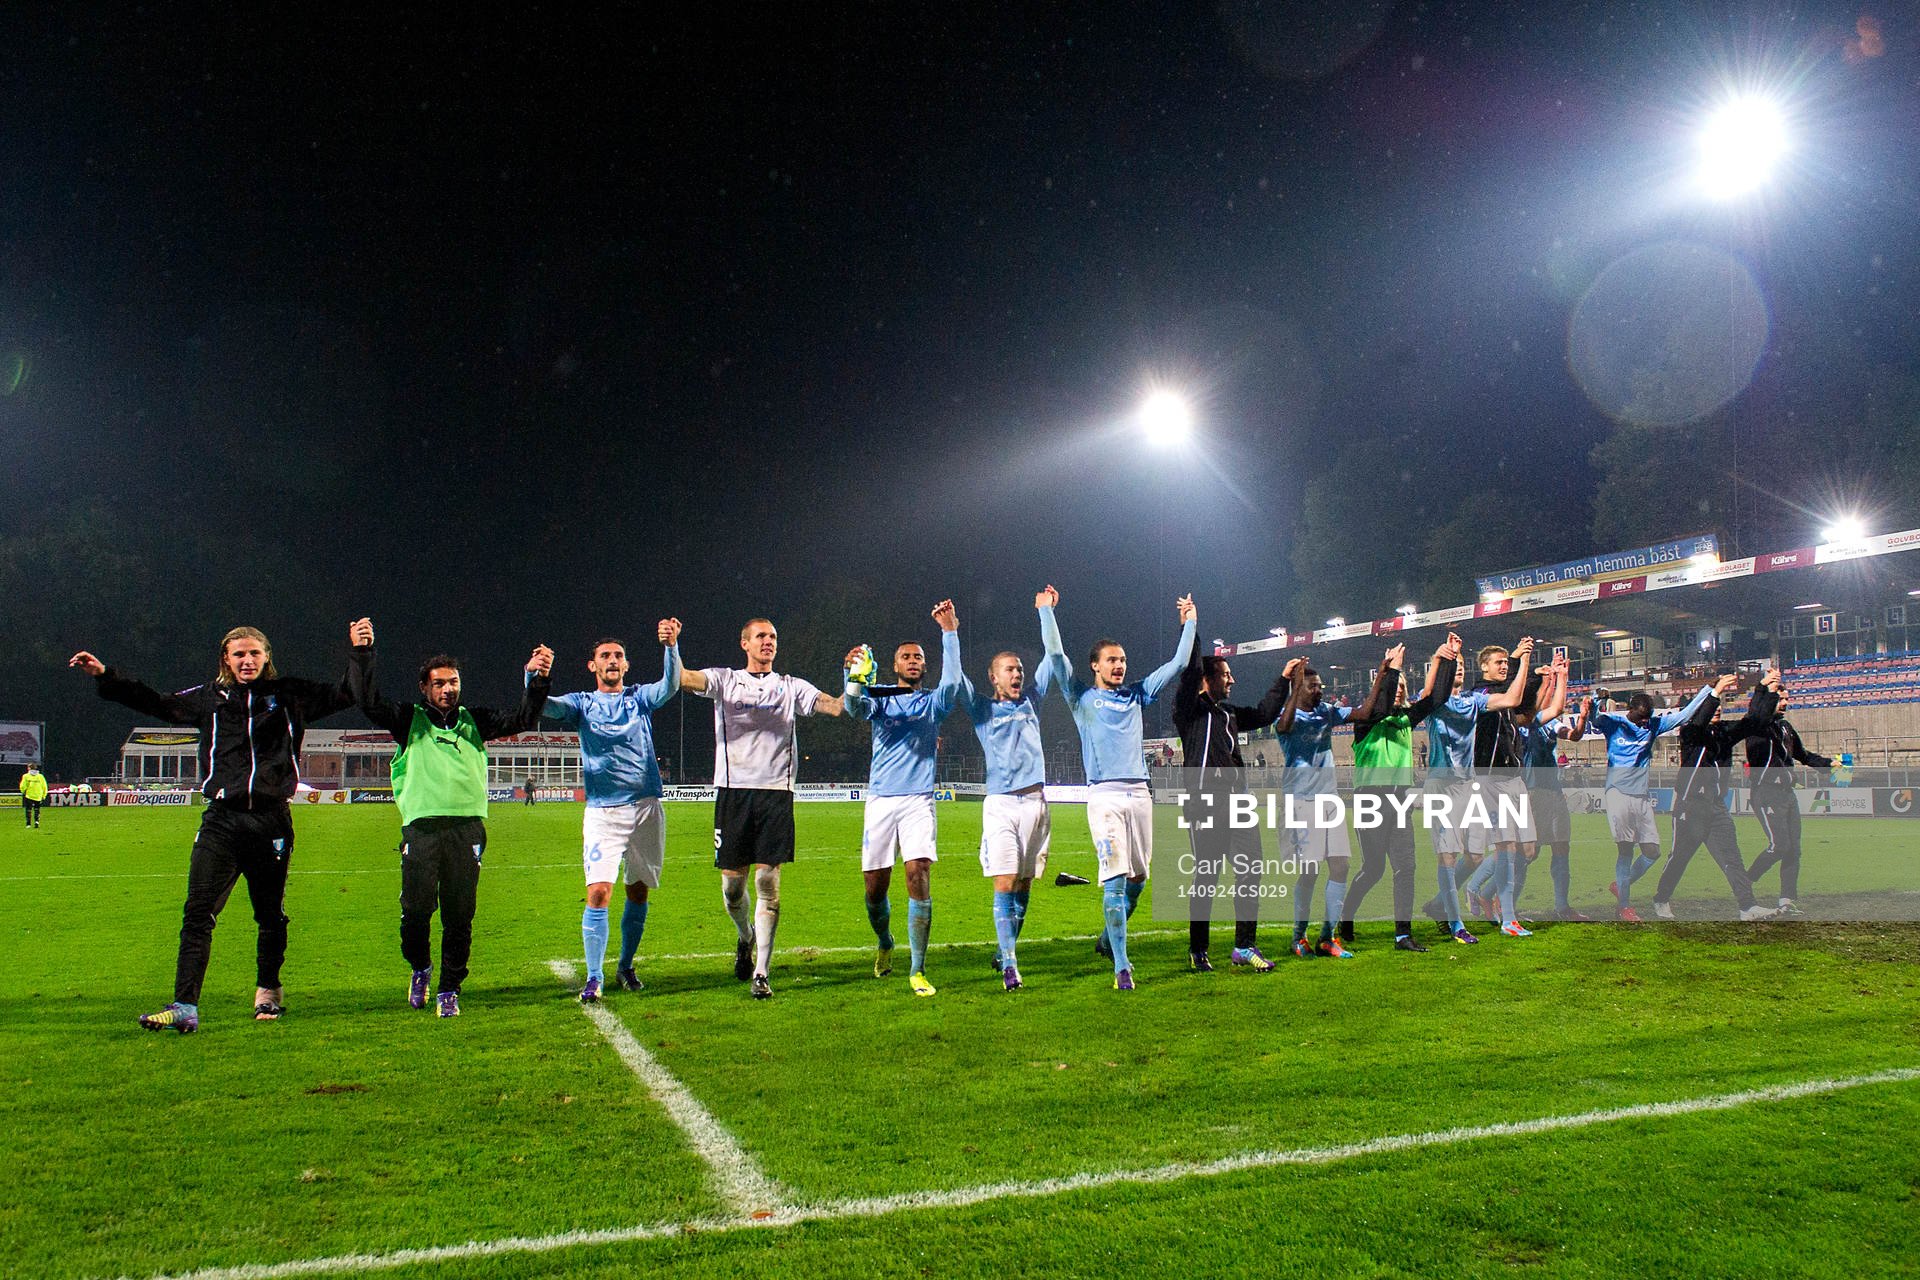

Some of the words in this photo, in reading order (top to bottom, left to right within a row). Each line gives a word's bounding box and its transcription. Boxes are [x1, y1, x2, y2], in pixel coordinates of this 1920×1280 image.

[1501, 574, 1532, 590] Borta
[1535, 569, 1560, 584] bra,
[1563, 563, 1592, 579] men
[1594, 554, 1646, 573] hemma
[1649, 544, 1681, 564] bäst
[113, 792, 187, 806] Autoexperten
[676, 790, 715, 800] Transport
